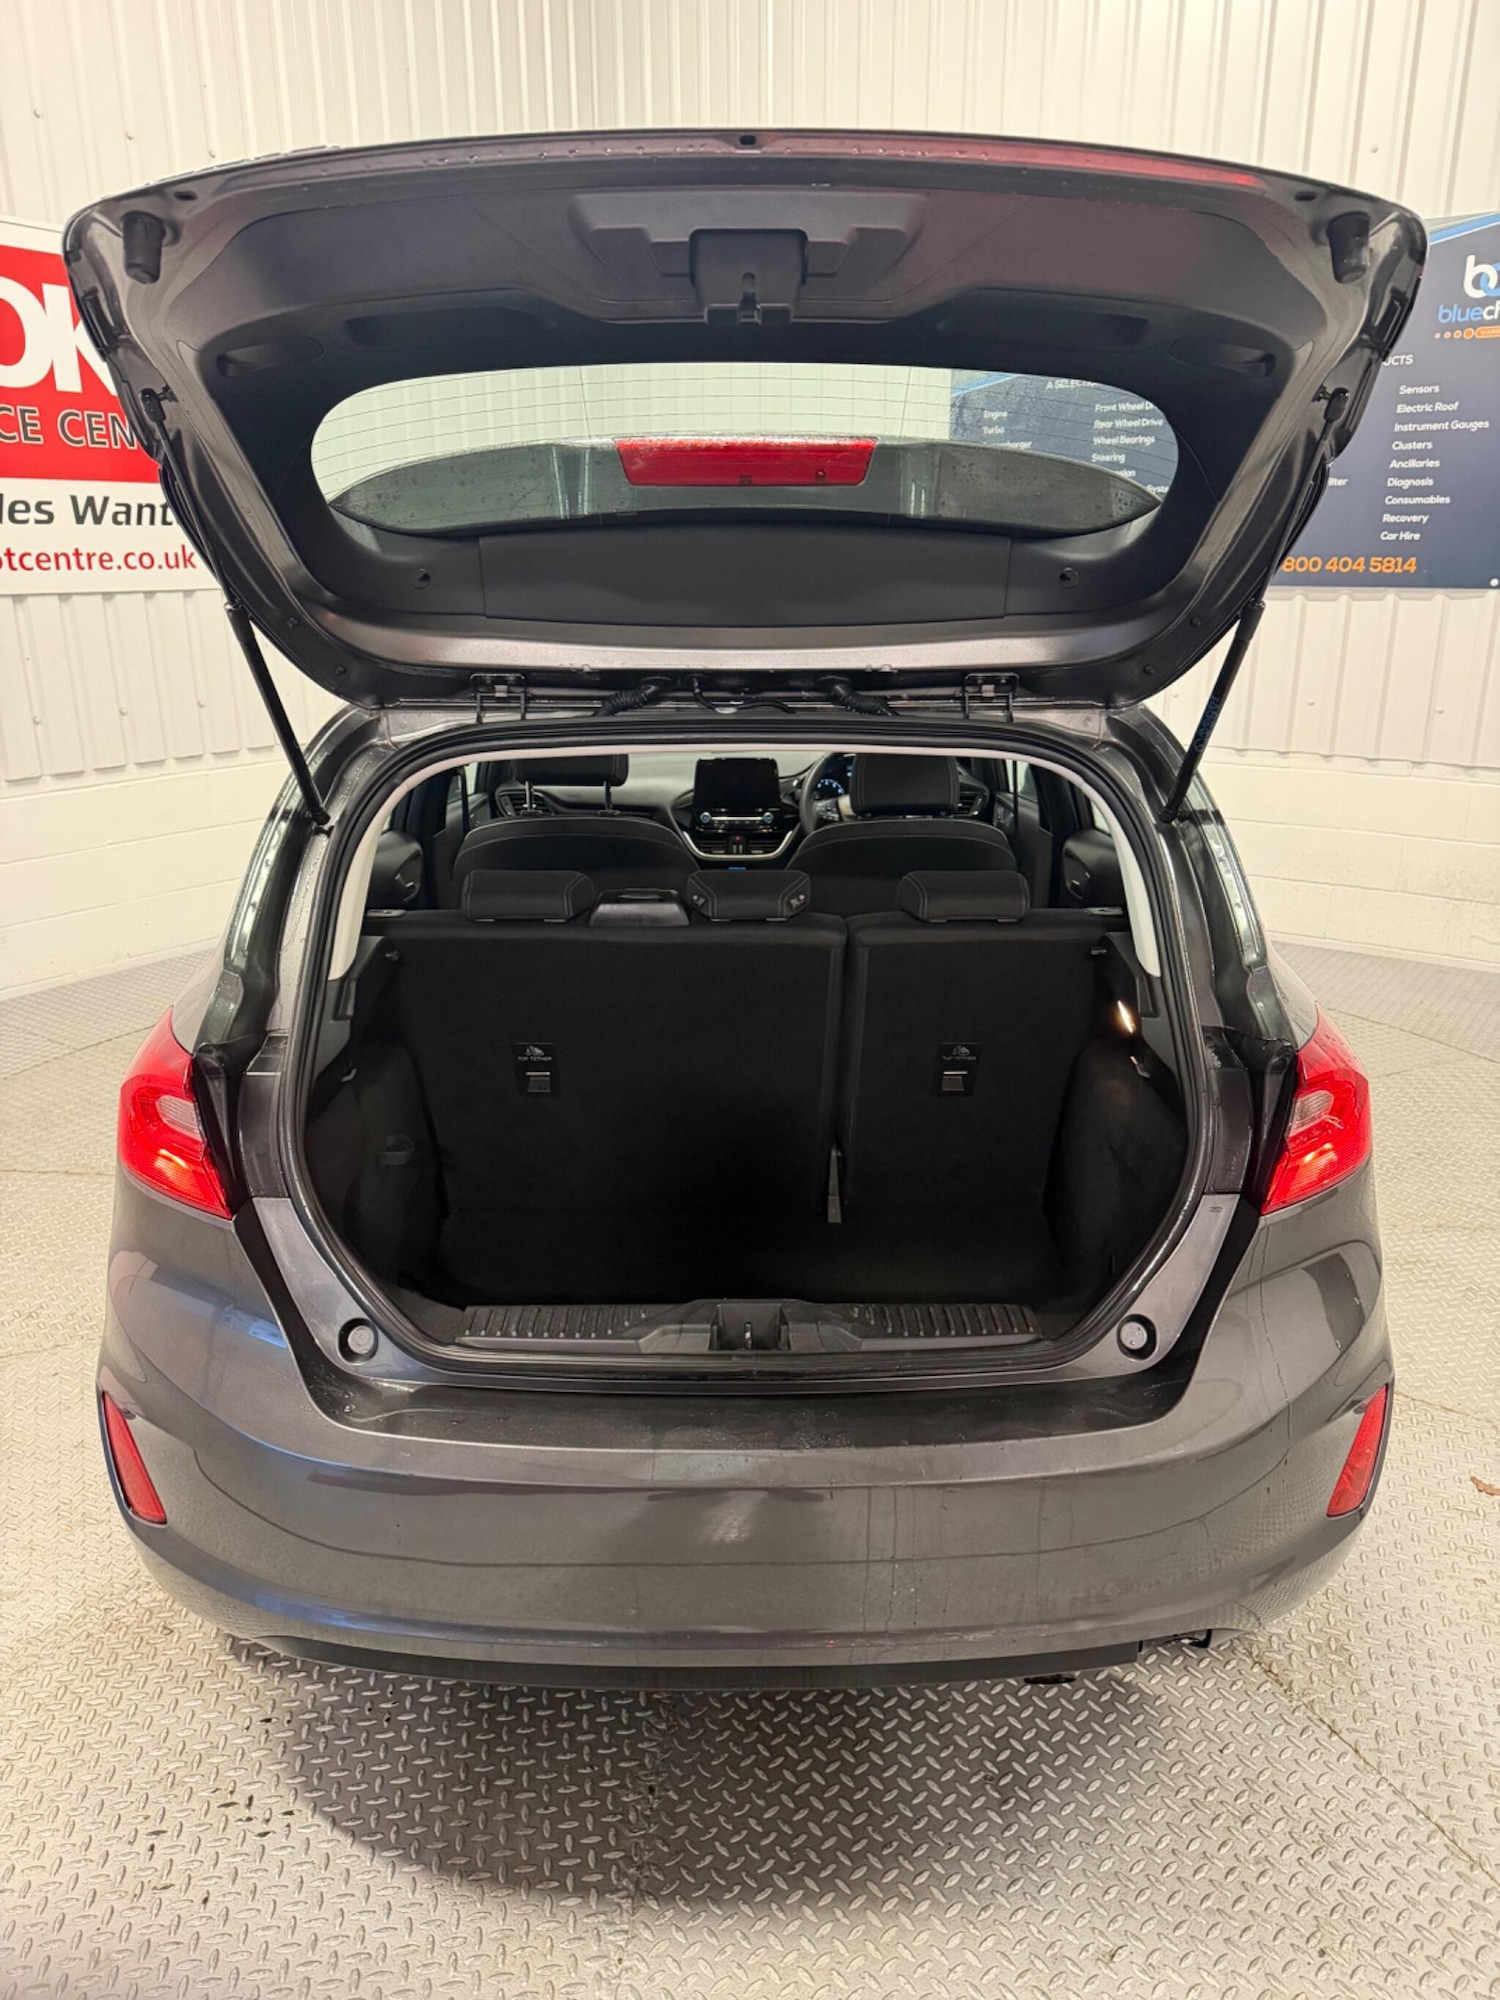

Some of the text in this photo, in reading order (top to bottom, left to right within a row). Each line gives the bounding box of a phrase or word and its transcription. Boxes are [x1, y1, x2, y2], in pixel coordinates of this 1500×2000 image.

[1399, 385, 1440, 395] Sensors
[1095, 403, 1117, 413] Front
[1118, 402, 1144, 411] Wheel
[1396, 401, 1460, 413] Electric Roof
[983, 410, 1008, 420] Engine
[1093, 417, 1164, 429] Rear Wheel Drive
[1394, 420, 1490, 432] Instrument Gauges
[983, 426, 1005, 435] Turbo
[1093, 435, 1156, 446] Wheel Bearings
[1392, 440, 1433, 450] Clusters
[1091, 453, 1126, 464] Steering
[1389, 458, 1440, 469] Ancillaries
[1387, 477, 1434, 489] Diagnosis
[1385, 495, 1451, 505] Consumables
[1382, 513, 1430, 525] Recovery
[1380, 531, 1420, 541] Car Hire
[0, 544, 197, 572] tcentre.co.uk
[1281, 556, 1417, 573] 800 404 5814
